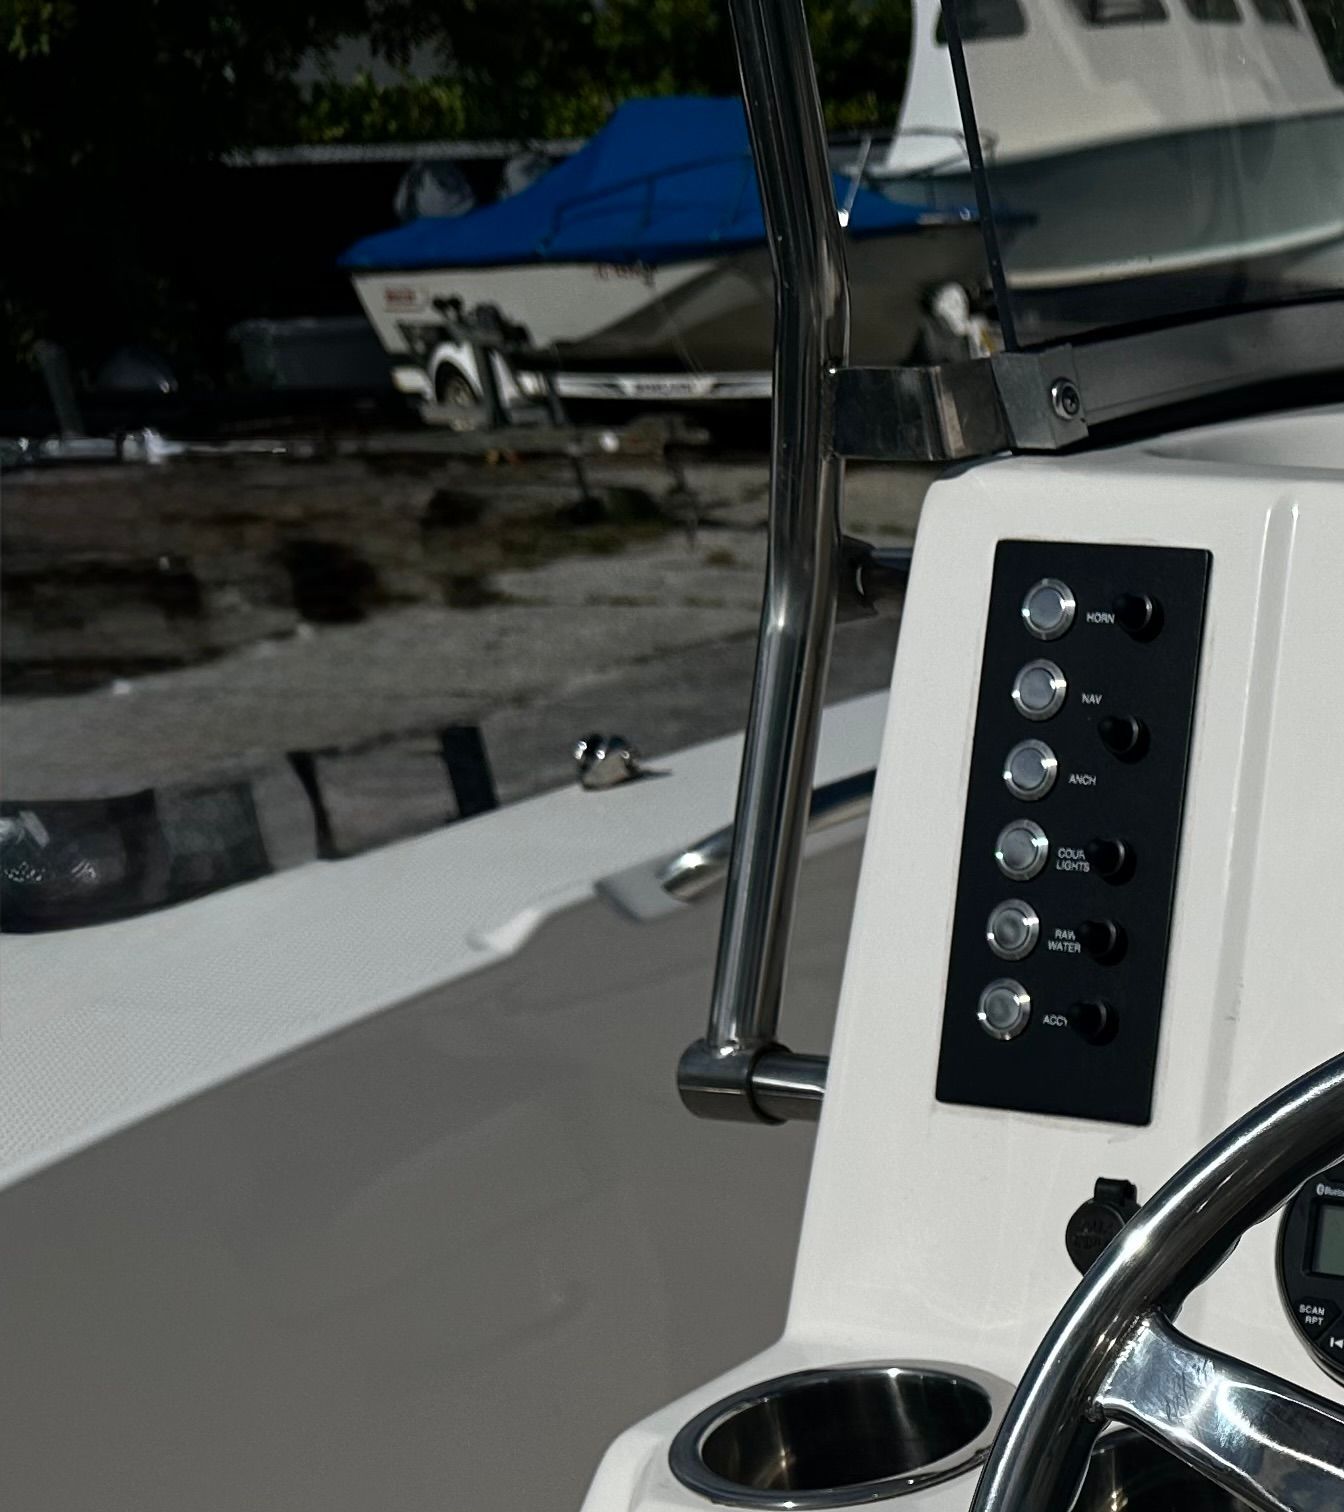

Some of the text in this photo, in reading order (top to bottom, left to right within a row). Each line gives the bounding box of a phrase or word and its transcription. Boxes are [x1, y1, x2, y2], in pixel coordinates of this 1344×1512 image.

[1086, 611, 1115, 624] HORN
[1081, 693, 1102, 705] NAV
[1068, 773, 1096, 786] ANCH
[1056, 860, 1090, 873] LIGHTS
[1048, 940, 1081, 954] WATER
[1299, 1304, 1325, 1316] SCAN
[1305, 1315, 1324, 1326] RPT
